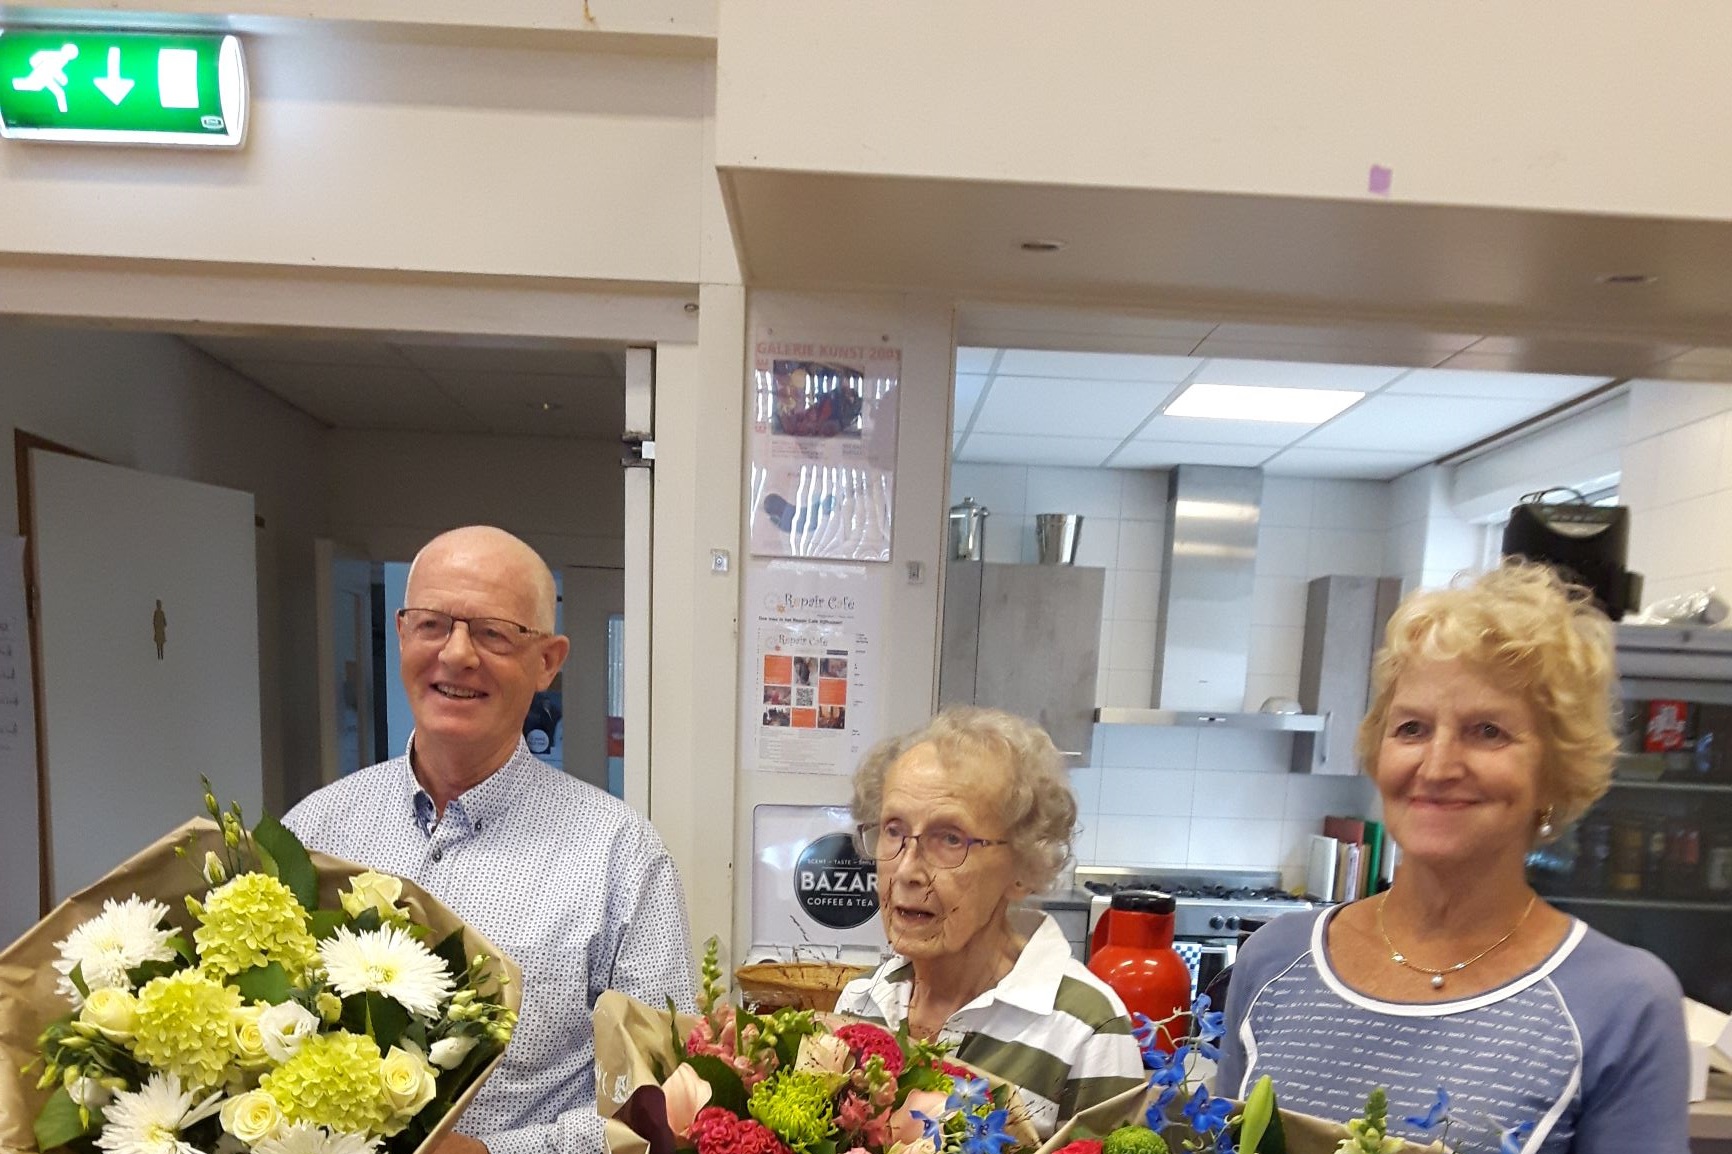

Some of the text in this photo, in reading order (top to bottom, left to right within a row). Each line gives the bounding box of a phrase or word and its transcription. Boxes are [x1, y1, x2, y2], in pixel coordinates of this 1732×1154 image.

[756, 343, 814, 357] GALERIE
[819, 345, 865, 358] KUNST
[785, 593, 824, 610] Repair
[801, 871, 878, 892] BAZAR
[807, 897, 874, 907] COFFEE & TEA
